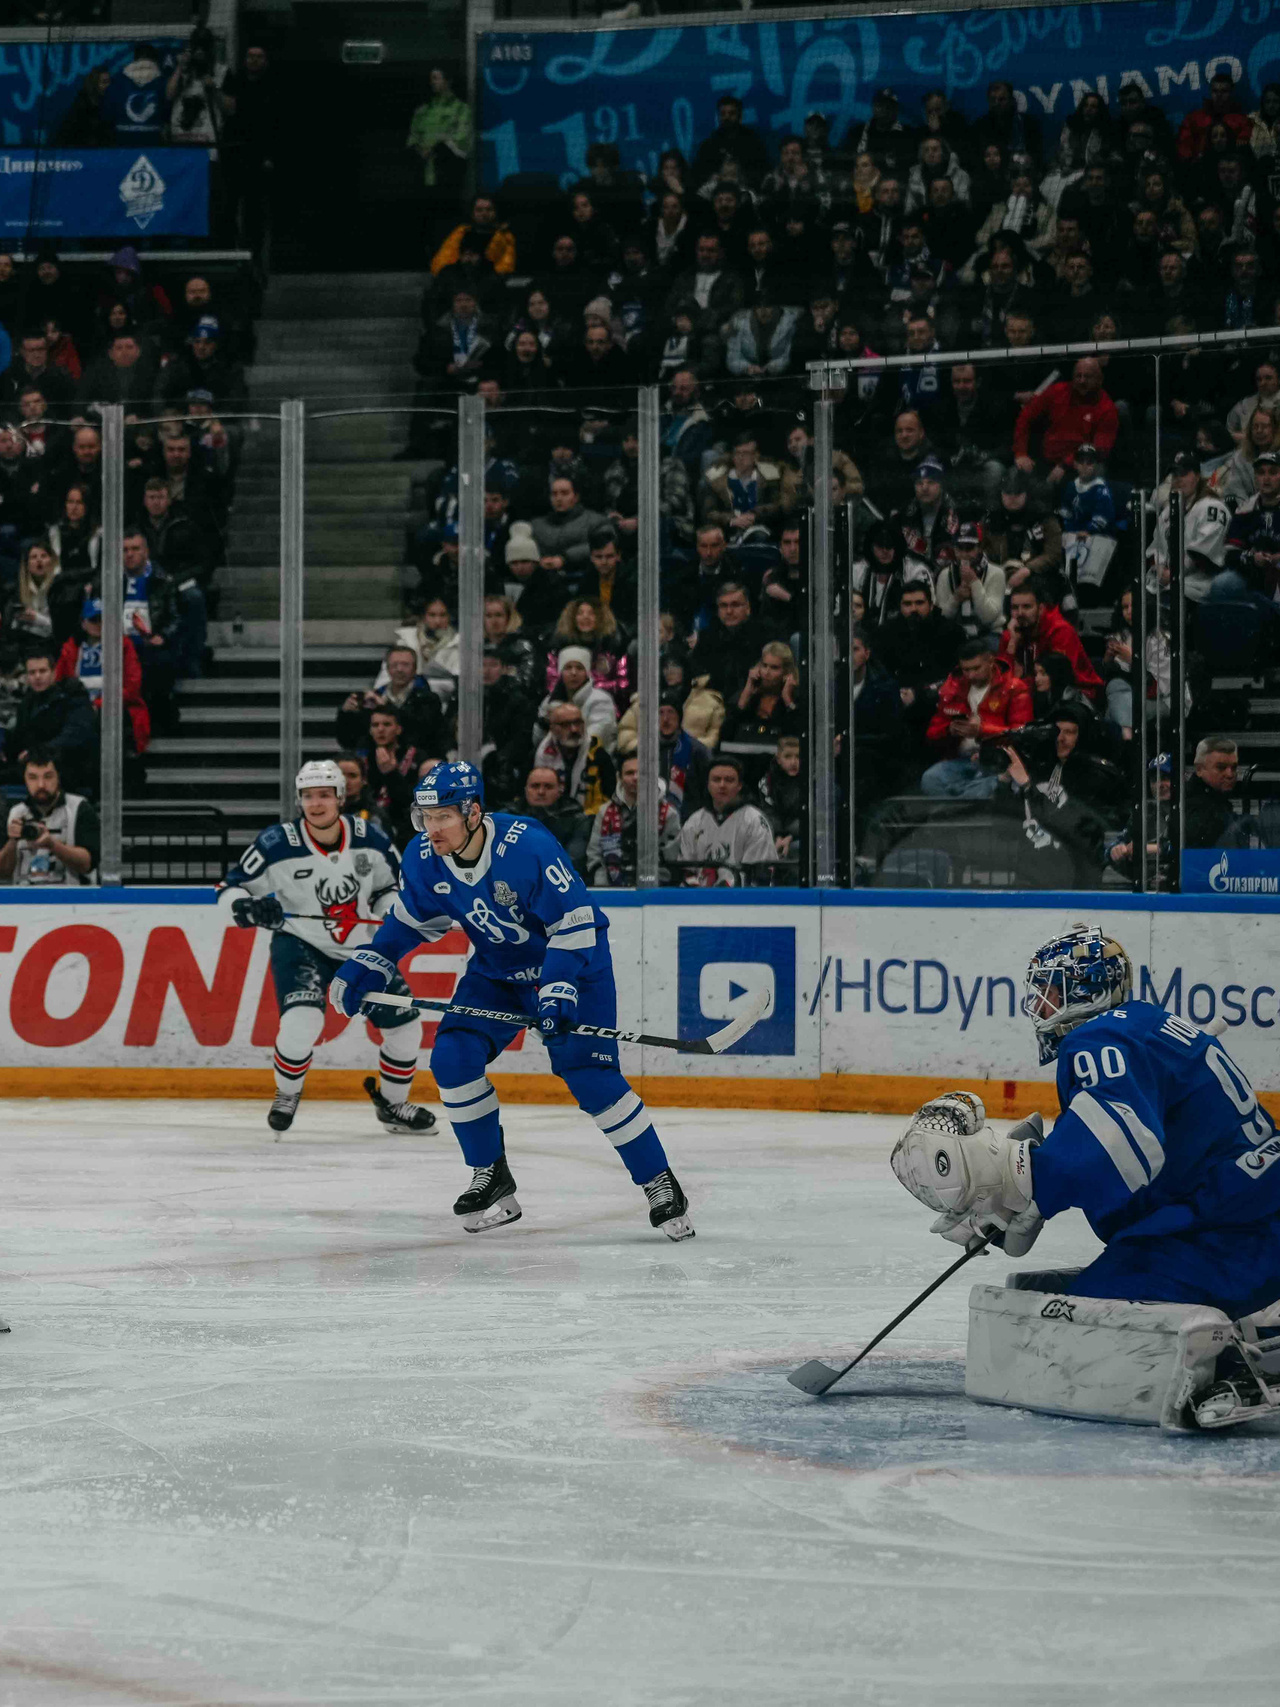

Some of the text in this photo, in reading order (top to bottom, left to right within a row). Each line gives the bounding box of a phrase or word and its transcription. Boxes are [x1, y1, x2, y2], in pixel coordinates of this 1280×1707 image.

[490, 45, 533, 61] A103
[504, 820, 528, 845] ВТБ
[1229, 877, 1280, 894] ГАЗПРОМ
[446, 1004, 512, 1021] JETSPEED
[576, 1024, 641, 1043] CCM
[1073, 1046, 1127, 1089] 90
